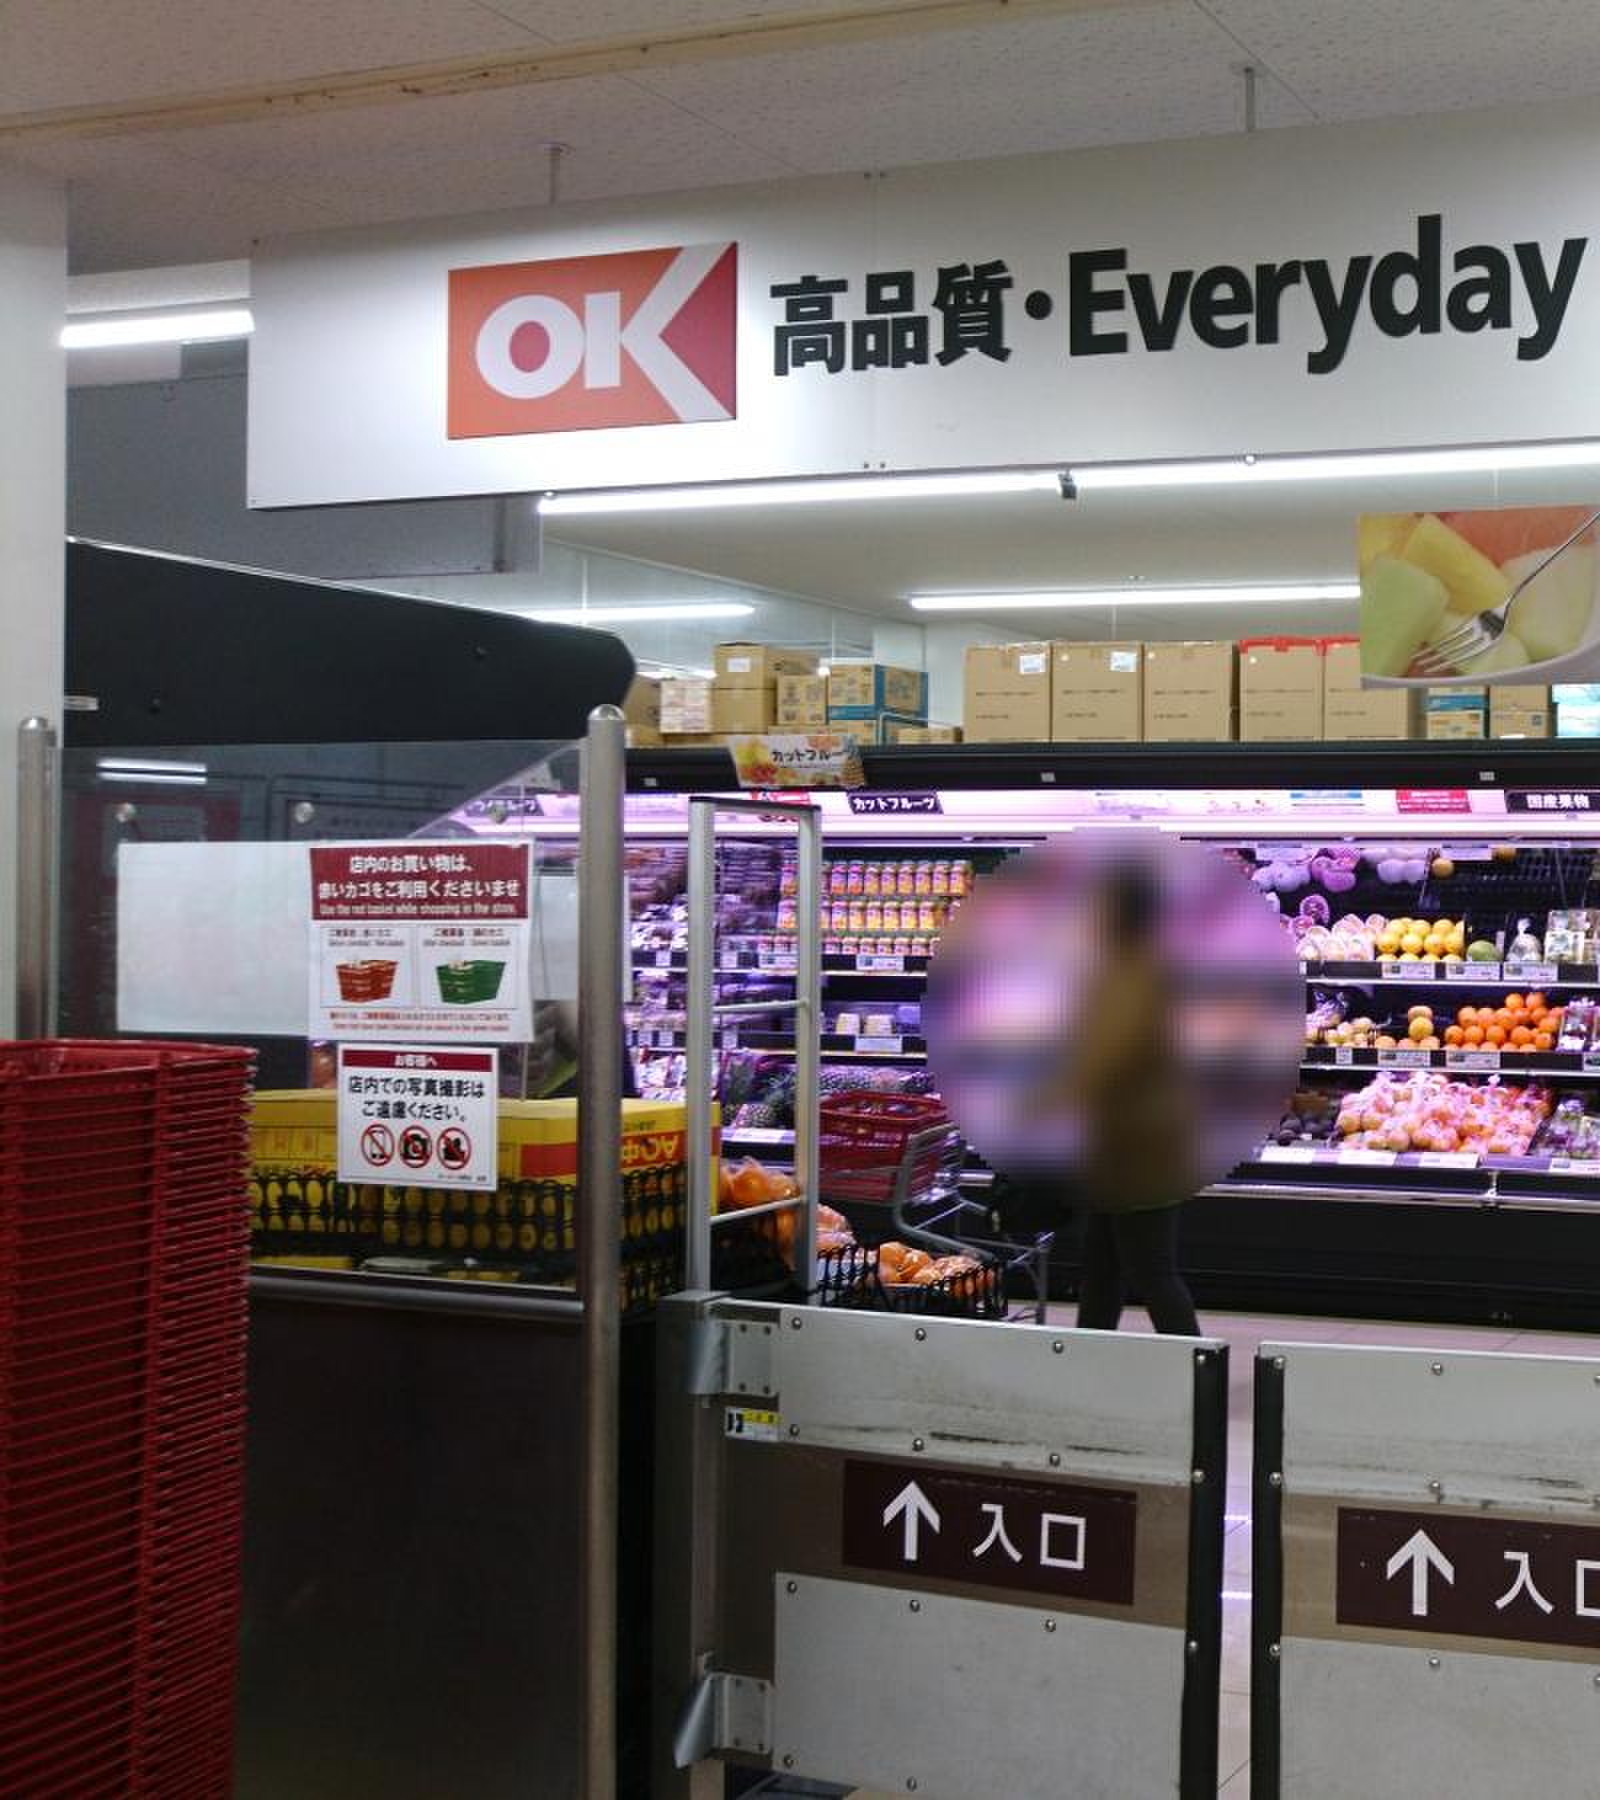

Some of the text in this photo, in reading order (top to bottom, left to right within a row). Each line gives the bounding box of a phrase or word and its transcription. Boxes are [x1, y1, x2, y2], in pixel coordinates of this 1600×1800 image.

[474, 242, 737, 422] OK
[853, 797, 935, 811] カットフルーツ
[1527, 793, 1590, 809] 国産果物
[349, 1076, 485, 1098] 店内での写真撮影は
[362, 1100, 467, 1122] ご遠慮ください。
[973, 1503, 1086, 1571] 入口
